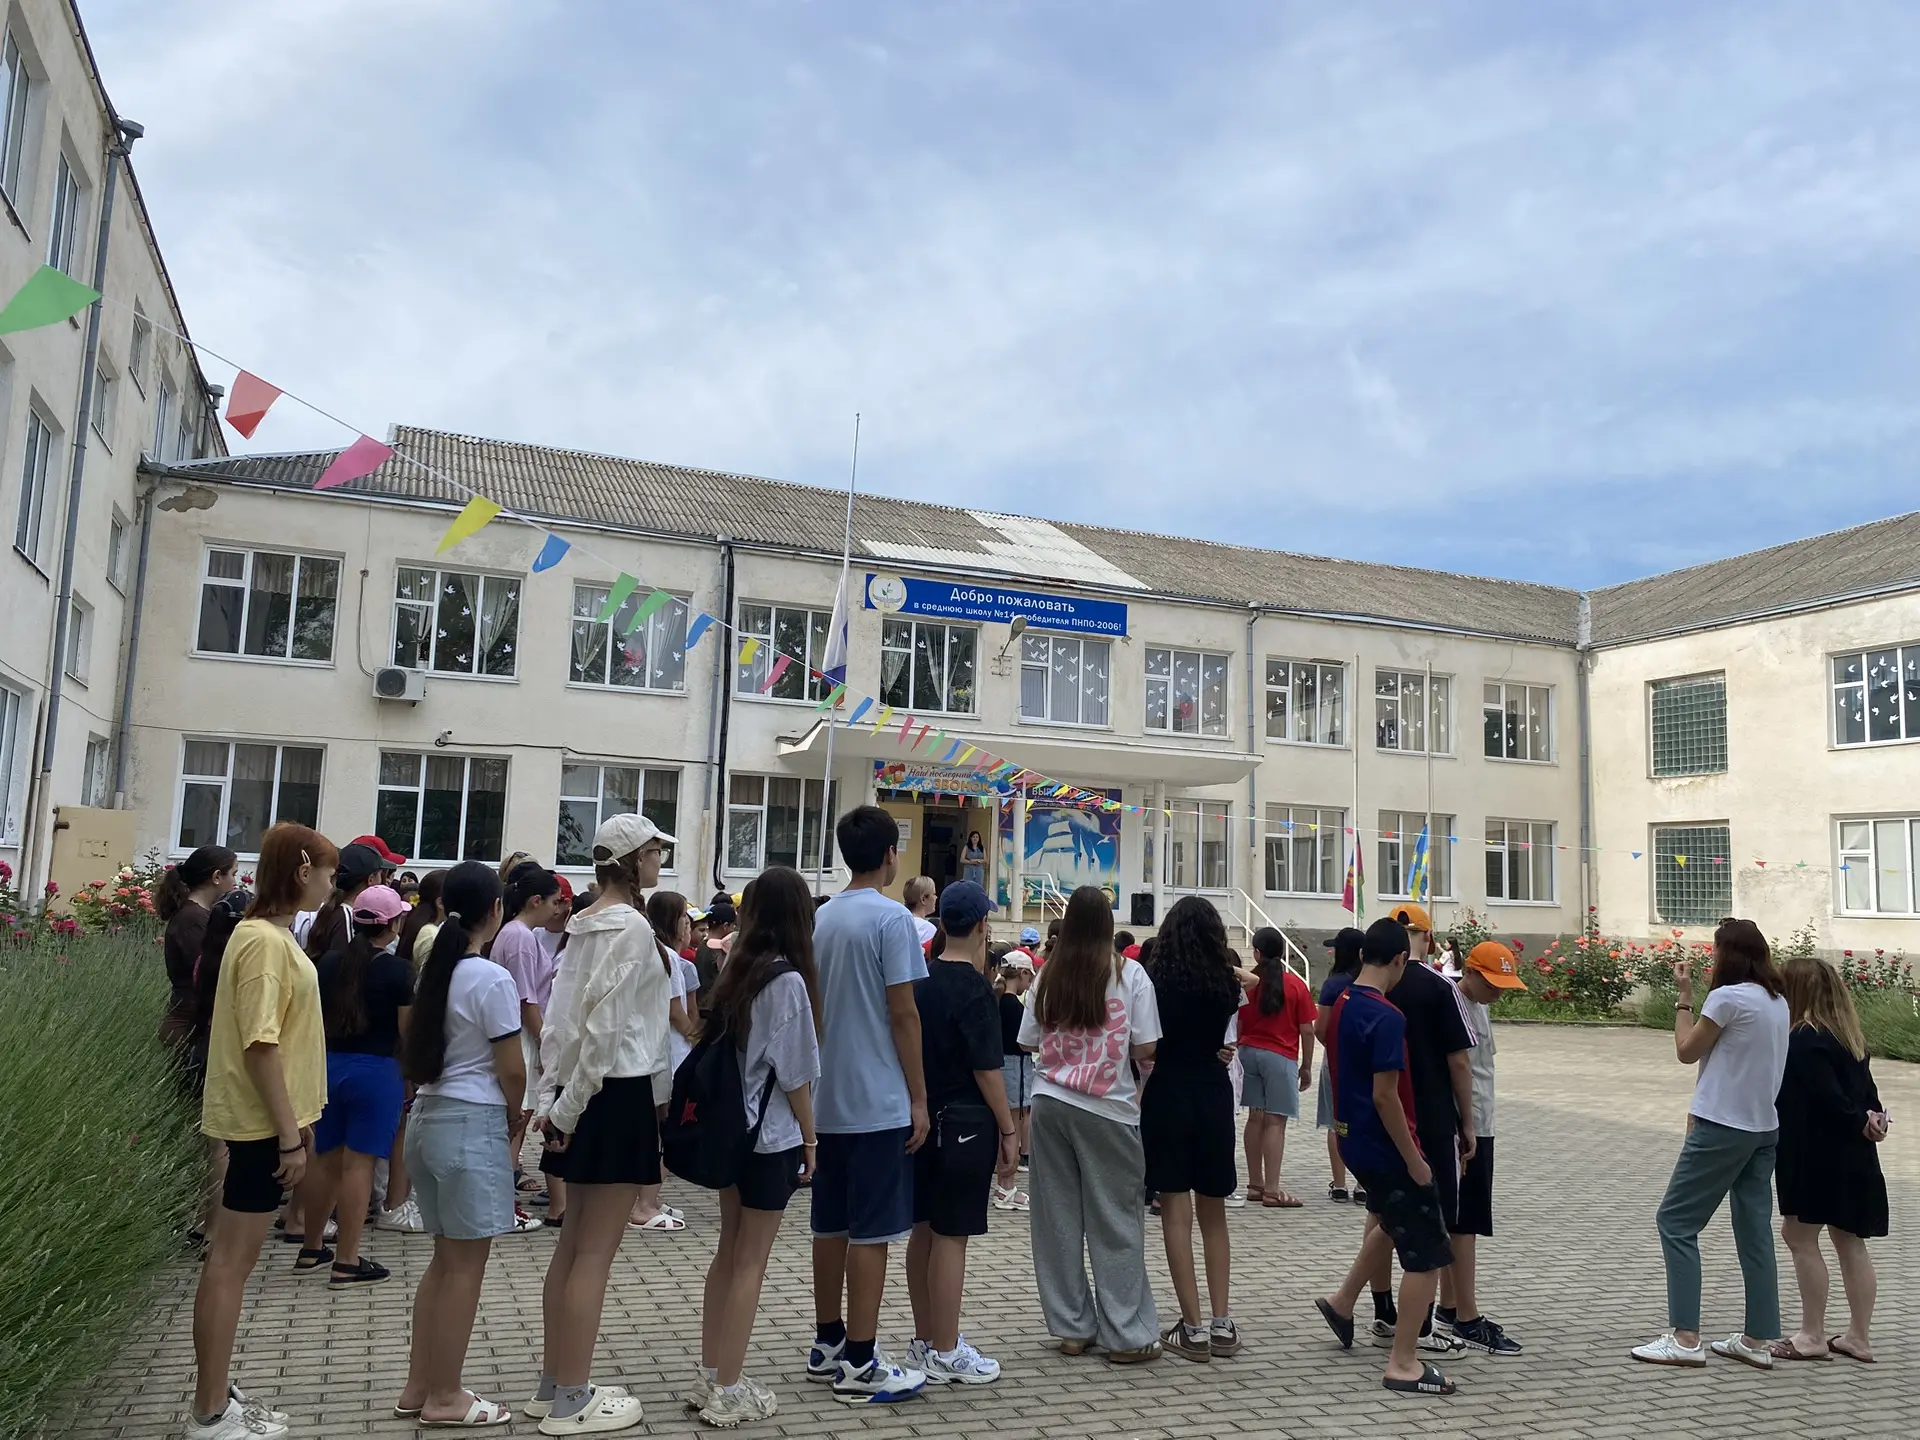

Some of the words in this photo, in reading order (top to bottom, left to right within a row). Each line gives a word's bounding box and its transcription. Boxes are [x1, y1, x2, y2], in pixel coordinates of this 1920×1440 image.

[950, 587, 993, 605] Добро
[997, 595, 1075, 613] пожаловать
[921, 602, 963, 613] среднюю
[965, 607, 992, 618] школу
[994, 609, 1015, 619] №14
[1071, 618, 1122, 631] ПНПО-2006!
[908, 768, 928, 778] Наш
[929, 770, 973, 782] последний
[932, 778, 992, 794] ЗВОНОК
[1500, 956, 1512, 973] LA
